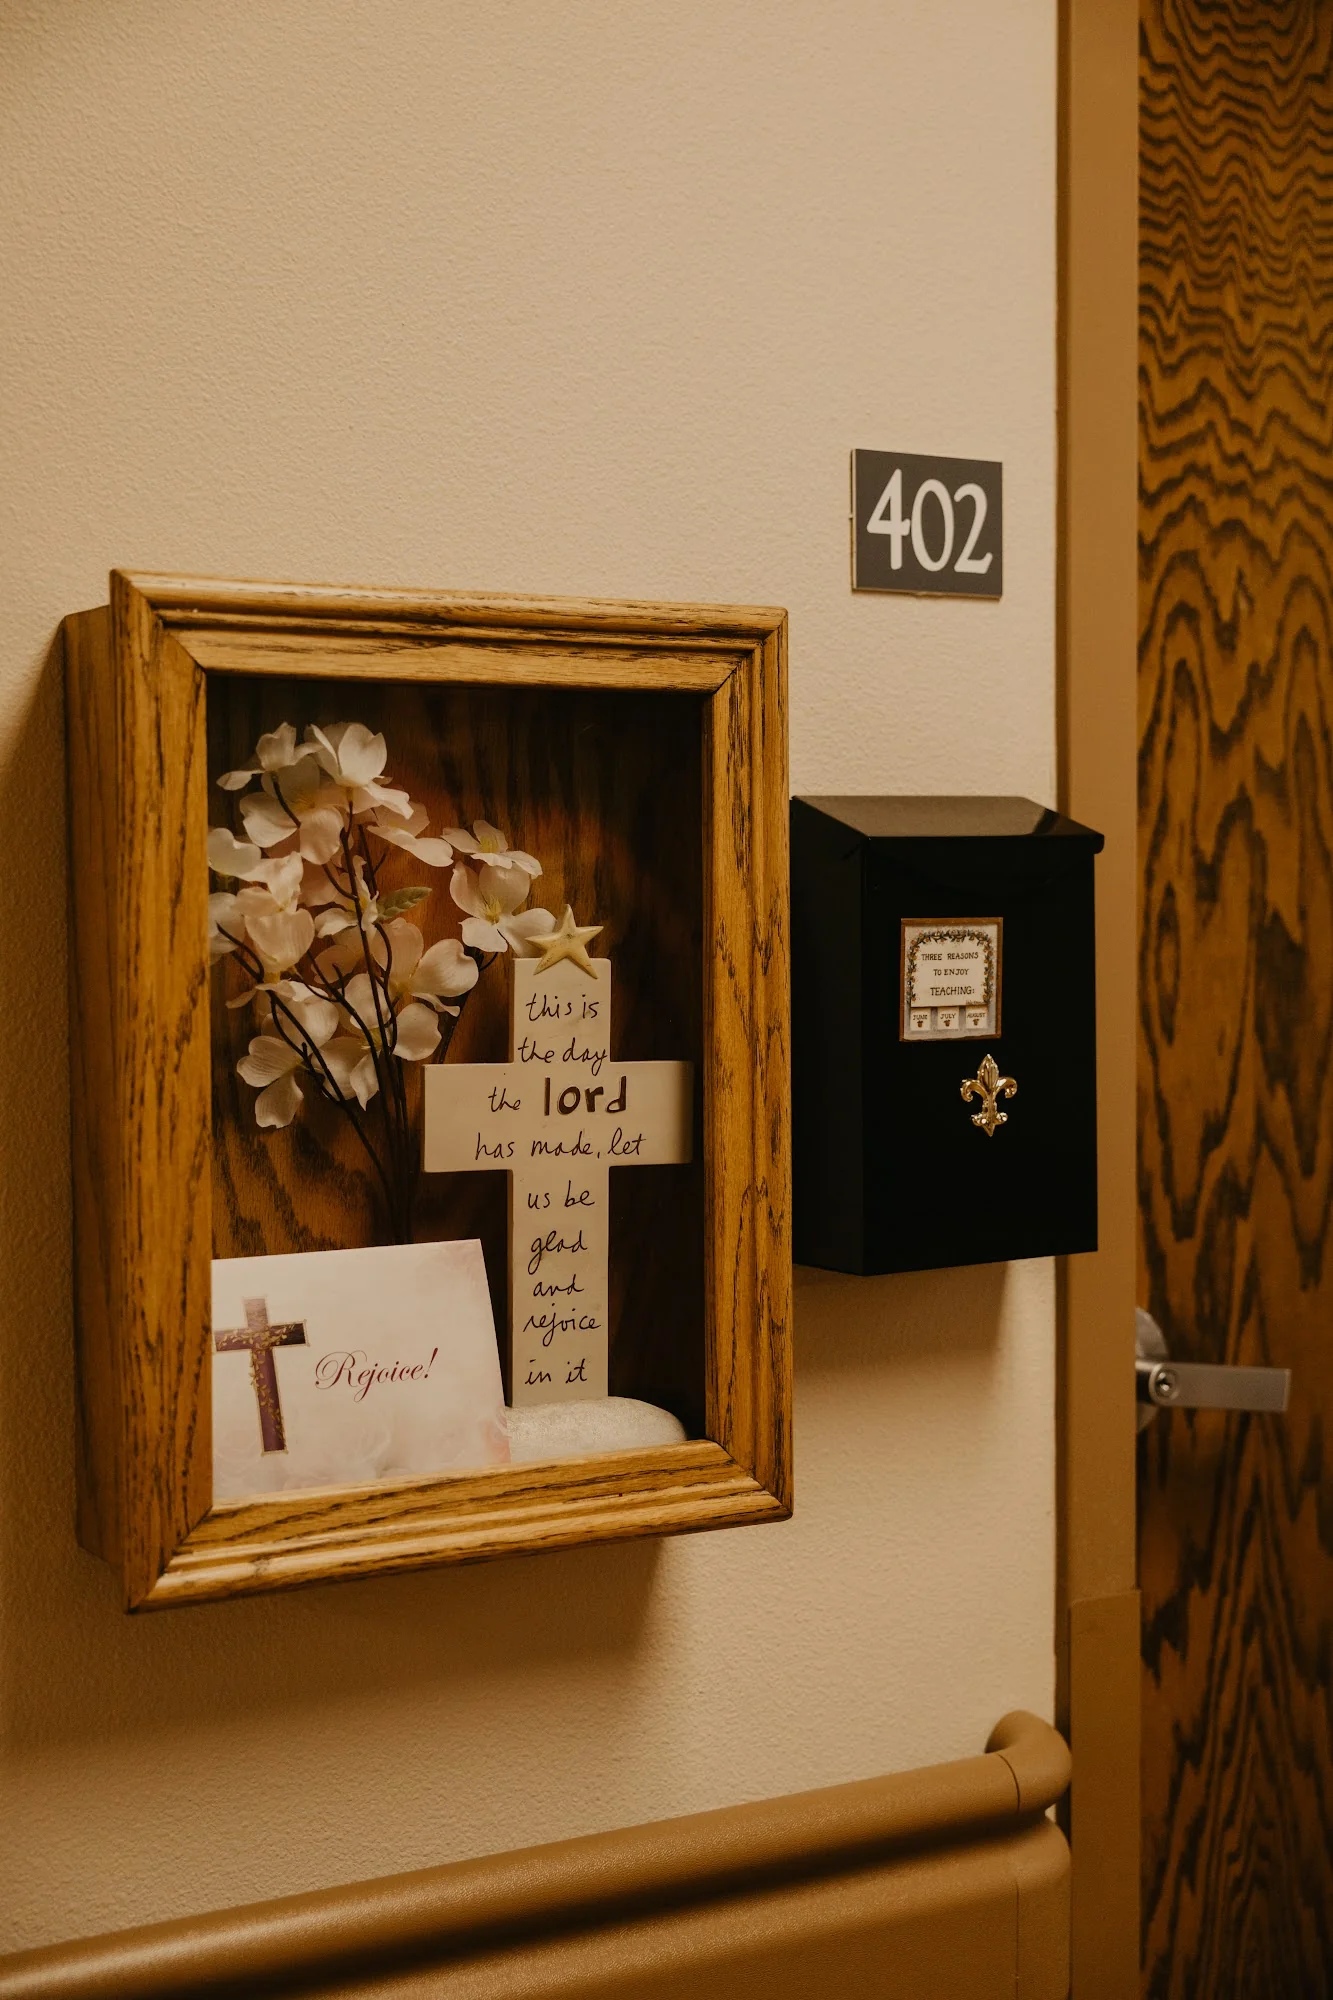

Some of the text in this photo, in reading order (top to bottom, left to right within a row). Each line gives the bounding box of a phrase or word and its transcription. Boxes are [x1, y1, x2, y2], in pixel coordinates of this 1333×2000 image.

[866, 468, 993, 574] 402
[921, 952, 979, 961] THREE REASONS
[933, 968, 970, 976] TO ENJOY
[930, 985, 975, 996] TEACHING:
[526, 993, 600, 1022] this is
[940, 1012, 956, 1020] JULY
[517, 1037, 609, 1076] the day
[487, 1075, 627, 1116] the lord
[475, 1127, 647, 1160] has made, let
[527, 1180, 595, 1209] us be
[527, 1230, 588, 1275] glad
[533, 1274, 584, 1296] and
[523, 1303, 602, 1347] rejoice
[315, 1347, 439, 1403] Rejoice!
[525, 1358, 588, 1385] in it
